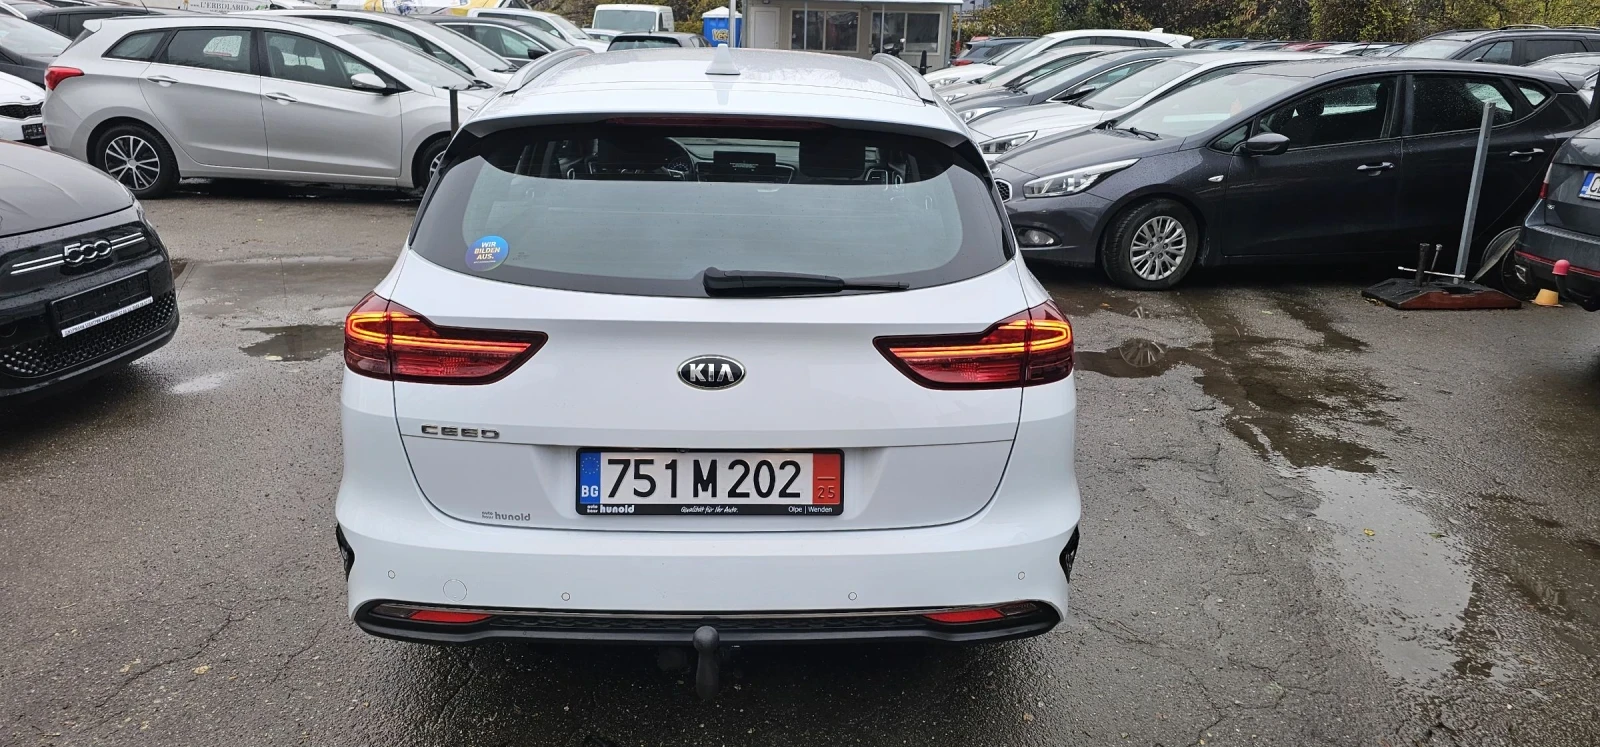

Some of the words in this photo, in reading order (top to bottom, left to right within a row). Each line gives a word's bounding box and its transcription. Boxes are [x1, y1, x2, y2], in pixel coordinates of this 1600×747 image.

[64, 240, 111, 263] 500
[689, 364, 734, 382] KIA
[422, 424, 500, 439] CEED
[581, 485, 599, 498] BG
[817, 486, 836, 499] 25
[600, 504, 634, 513] hunold
[495, 512, 530, 521] hunold
